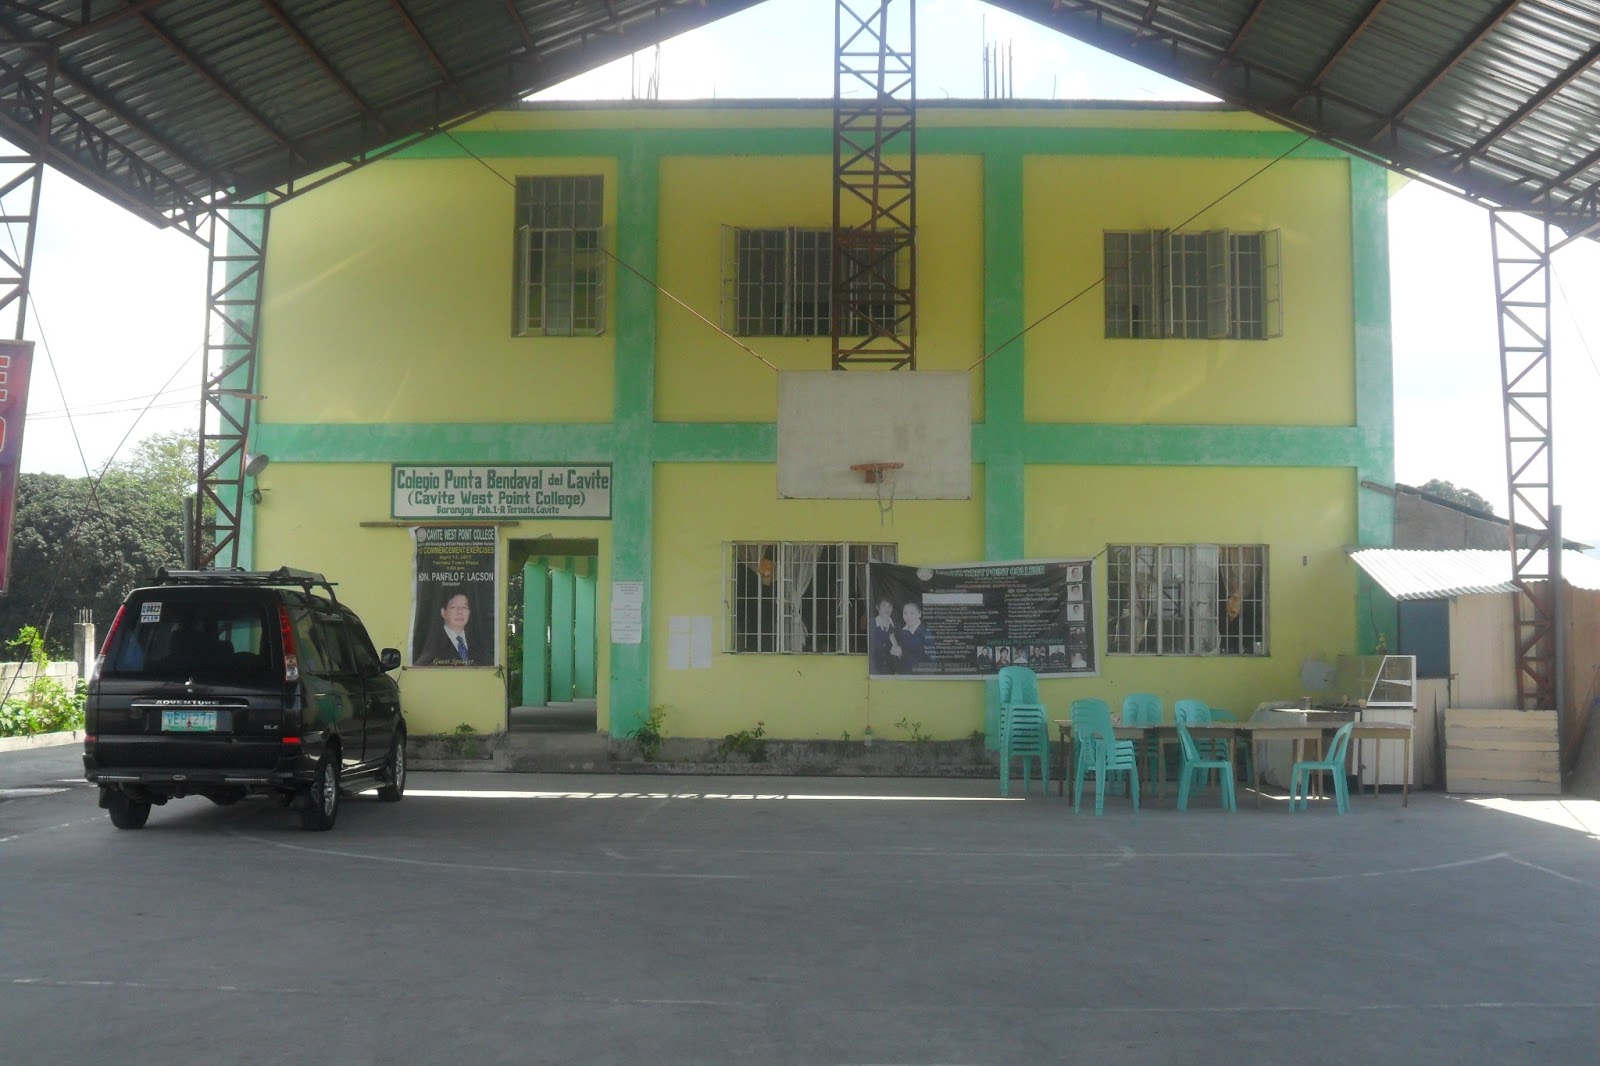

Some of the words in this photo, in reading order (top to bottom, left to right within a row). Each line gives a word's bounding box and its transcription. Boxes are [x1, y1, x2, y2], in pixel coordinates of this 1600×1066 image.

[397, 470, 440, 493] Colegio
[444, 470, 482, 489] Punta
[487, 469, 542, 489] Bendaval
[548, 473, 563, 486] del
[567, 470, 609, 489] Cavite
[407, 489, 455, 507] (Cavite
[460, 491, 493, 505] West
[498, 491, 530, 505] Point
[536, 489, 586, 509] College)
[437, 505, 474, 515] Barangay
[426, 529, 443, 541] CAVITE
[444, 529, 457, 541] WEST
[458, 529, 472, 541] POINT
[473, 529, 494, 541] COLLEGE
[431, 572, 459, 581] PANFILO
[460, 572, 466, 581] F.
[467, 572, 494, 581] LACSON
[986, 567, 1010, 577] POINT
[1010, 565, 1046, 577] COLLEGE
